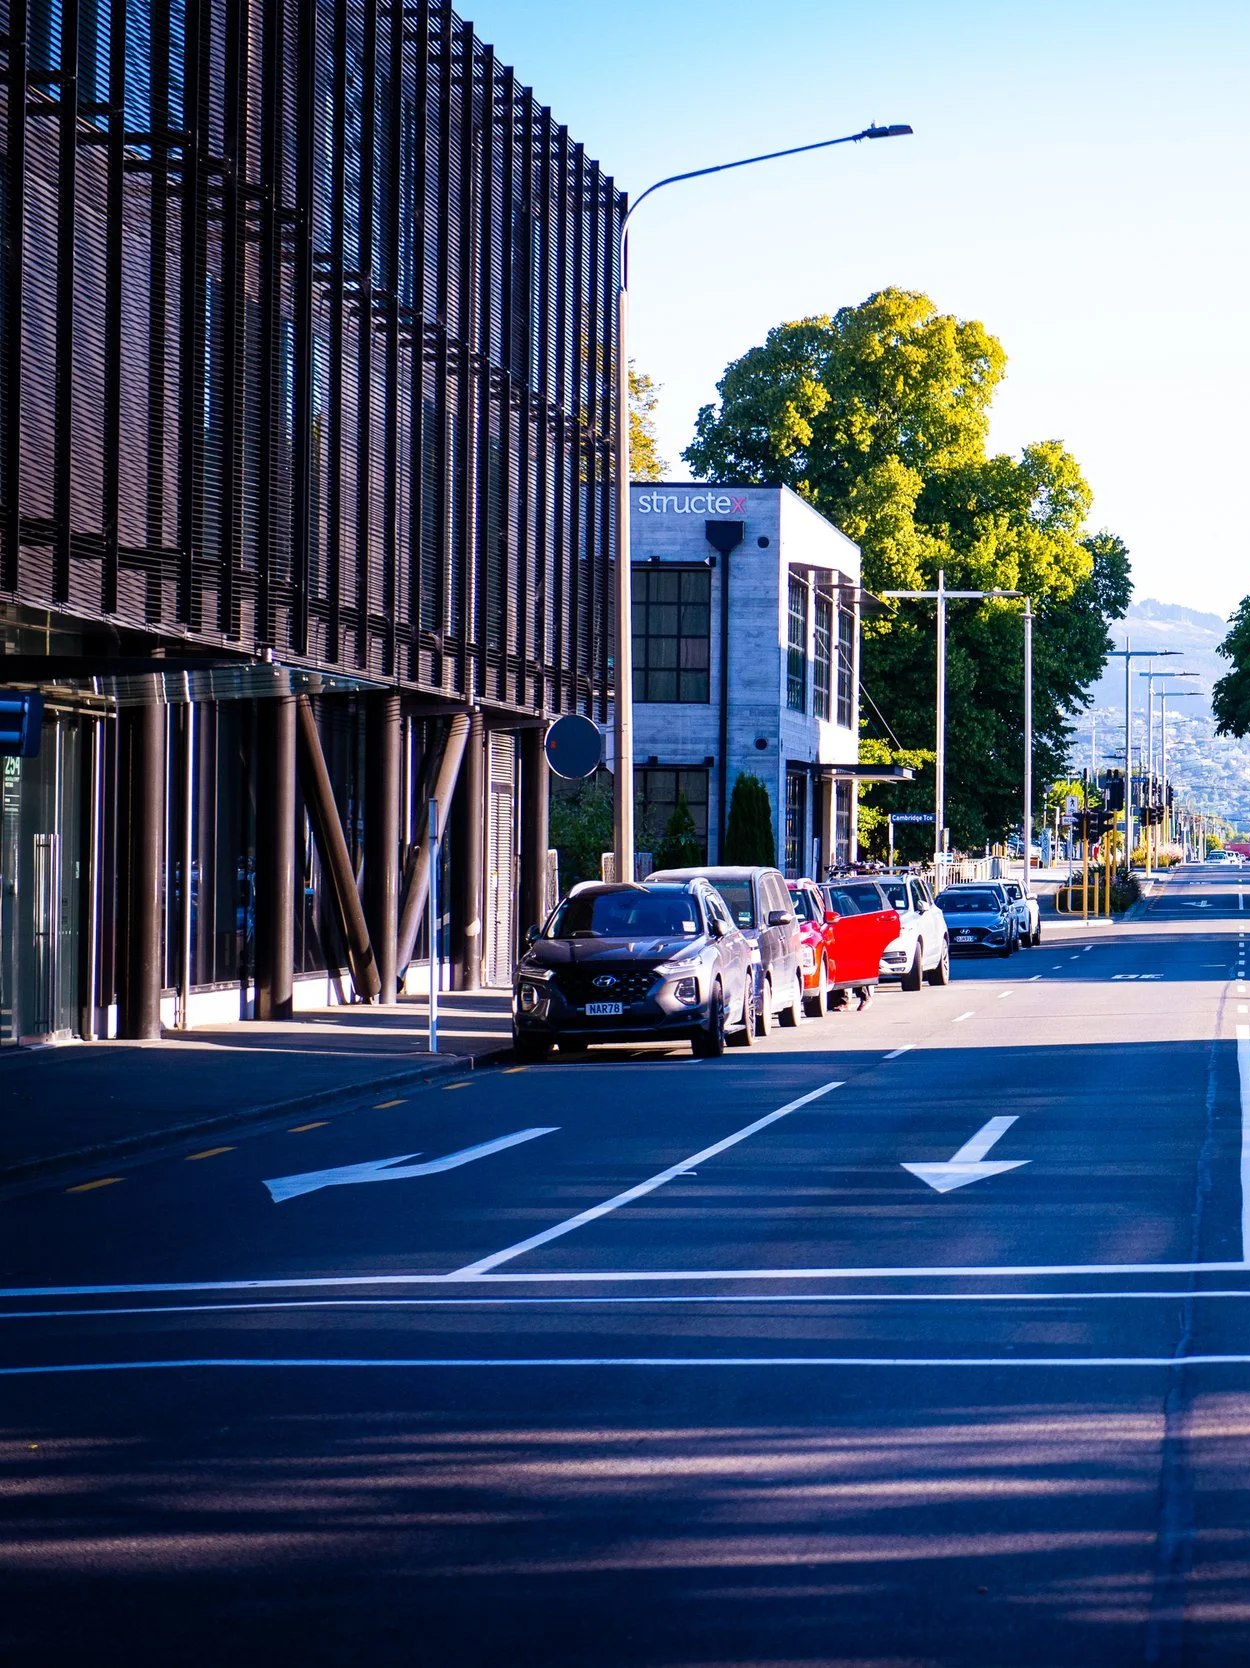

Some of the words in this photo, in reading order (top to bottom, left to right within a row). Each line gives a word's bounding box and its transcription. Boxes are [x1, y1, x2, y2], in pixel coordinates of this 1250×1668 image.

[638, 491, 746, 514] structex
[892, 814, 922, 822] Cambridge
[589, 1003, 620, 1015] NAR78
